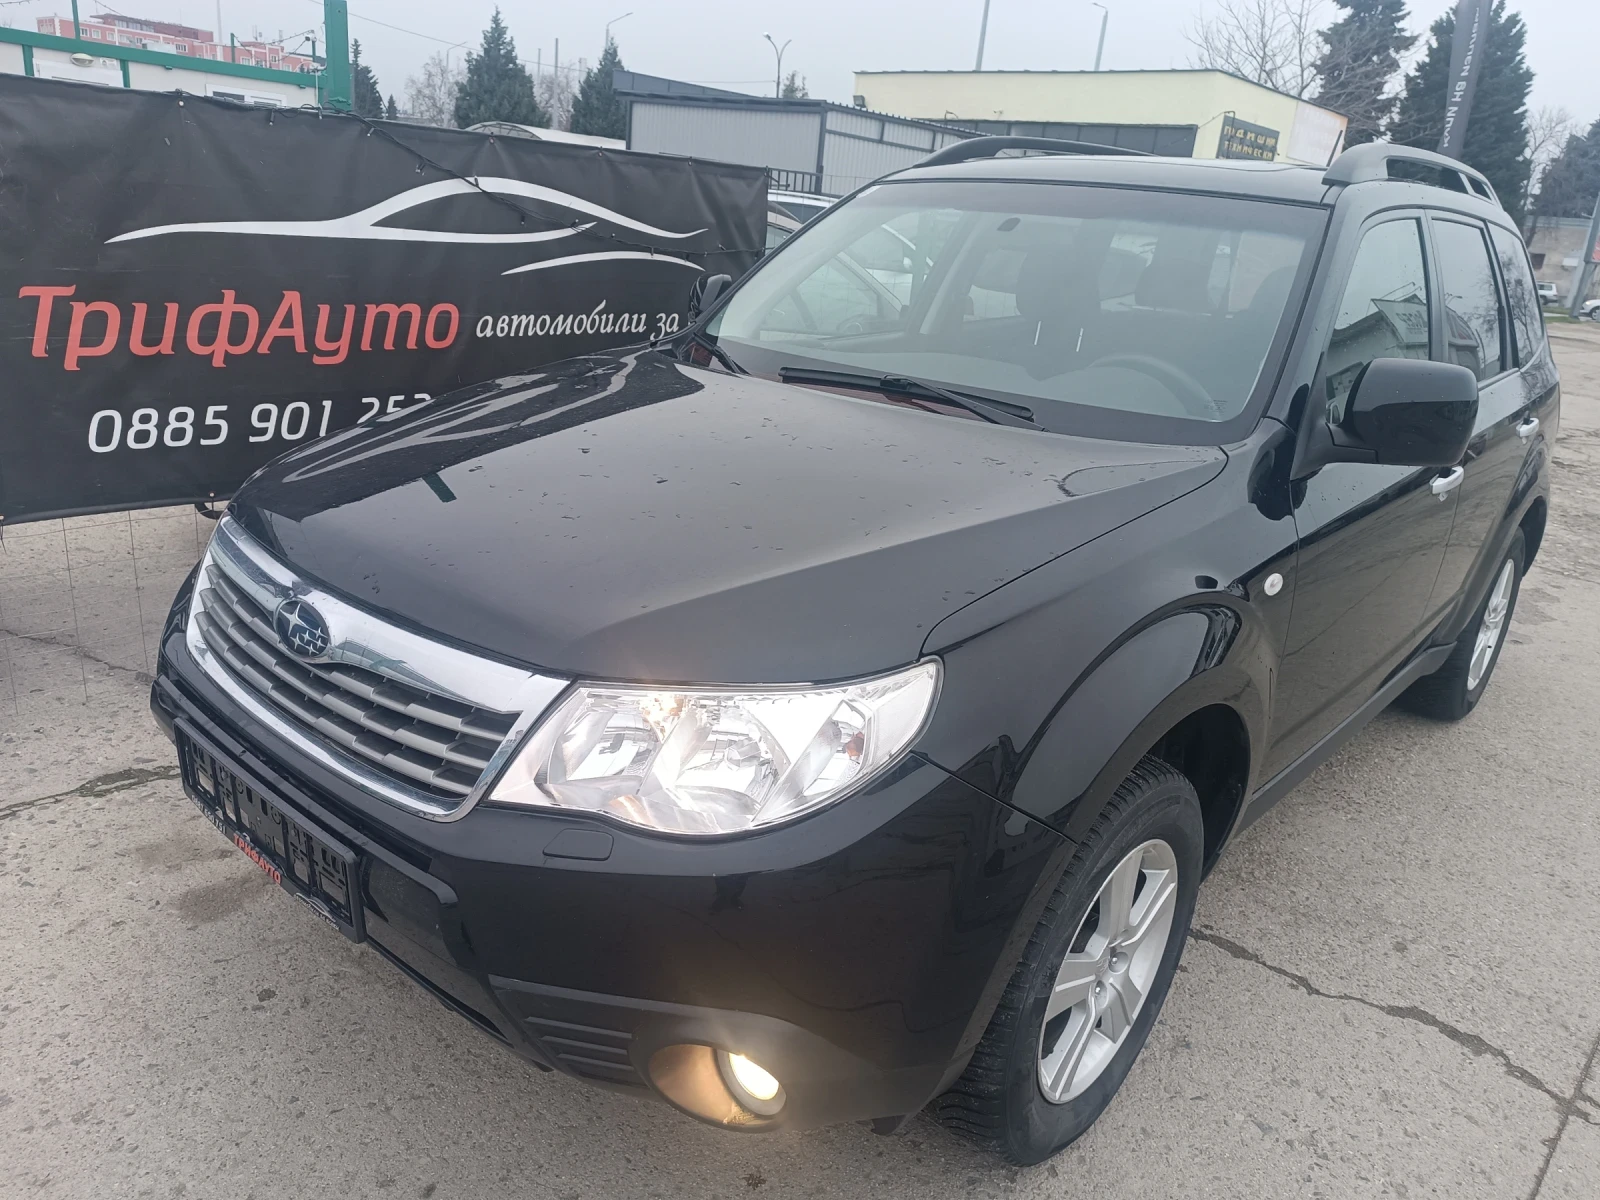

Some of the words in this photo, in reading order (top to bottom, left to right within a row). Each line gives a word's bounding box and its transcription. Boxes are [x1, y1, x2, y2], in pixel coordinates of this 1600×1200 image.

[18, 284, 460, 371] ТрифАуто
[476, 299, 647, 338] автомобили
[650, 312, 680, 341] за
[88, 404, 229, 453] 0885
[248, 400, 333, 443] 901
[233, 832, 282, 885] ТРИФАУТО
